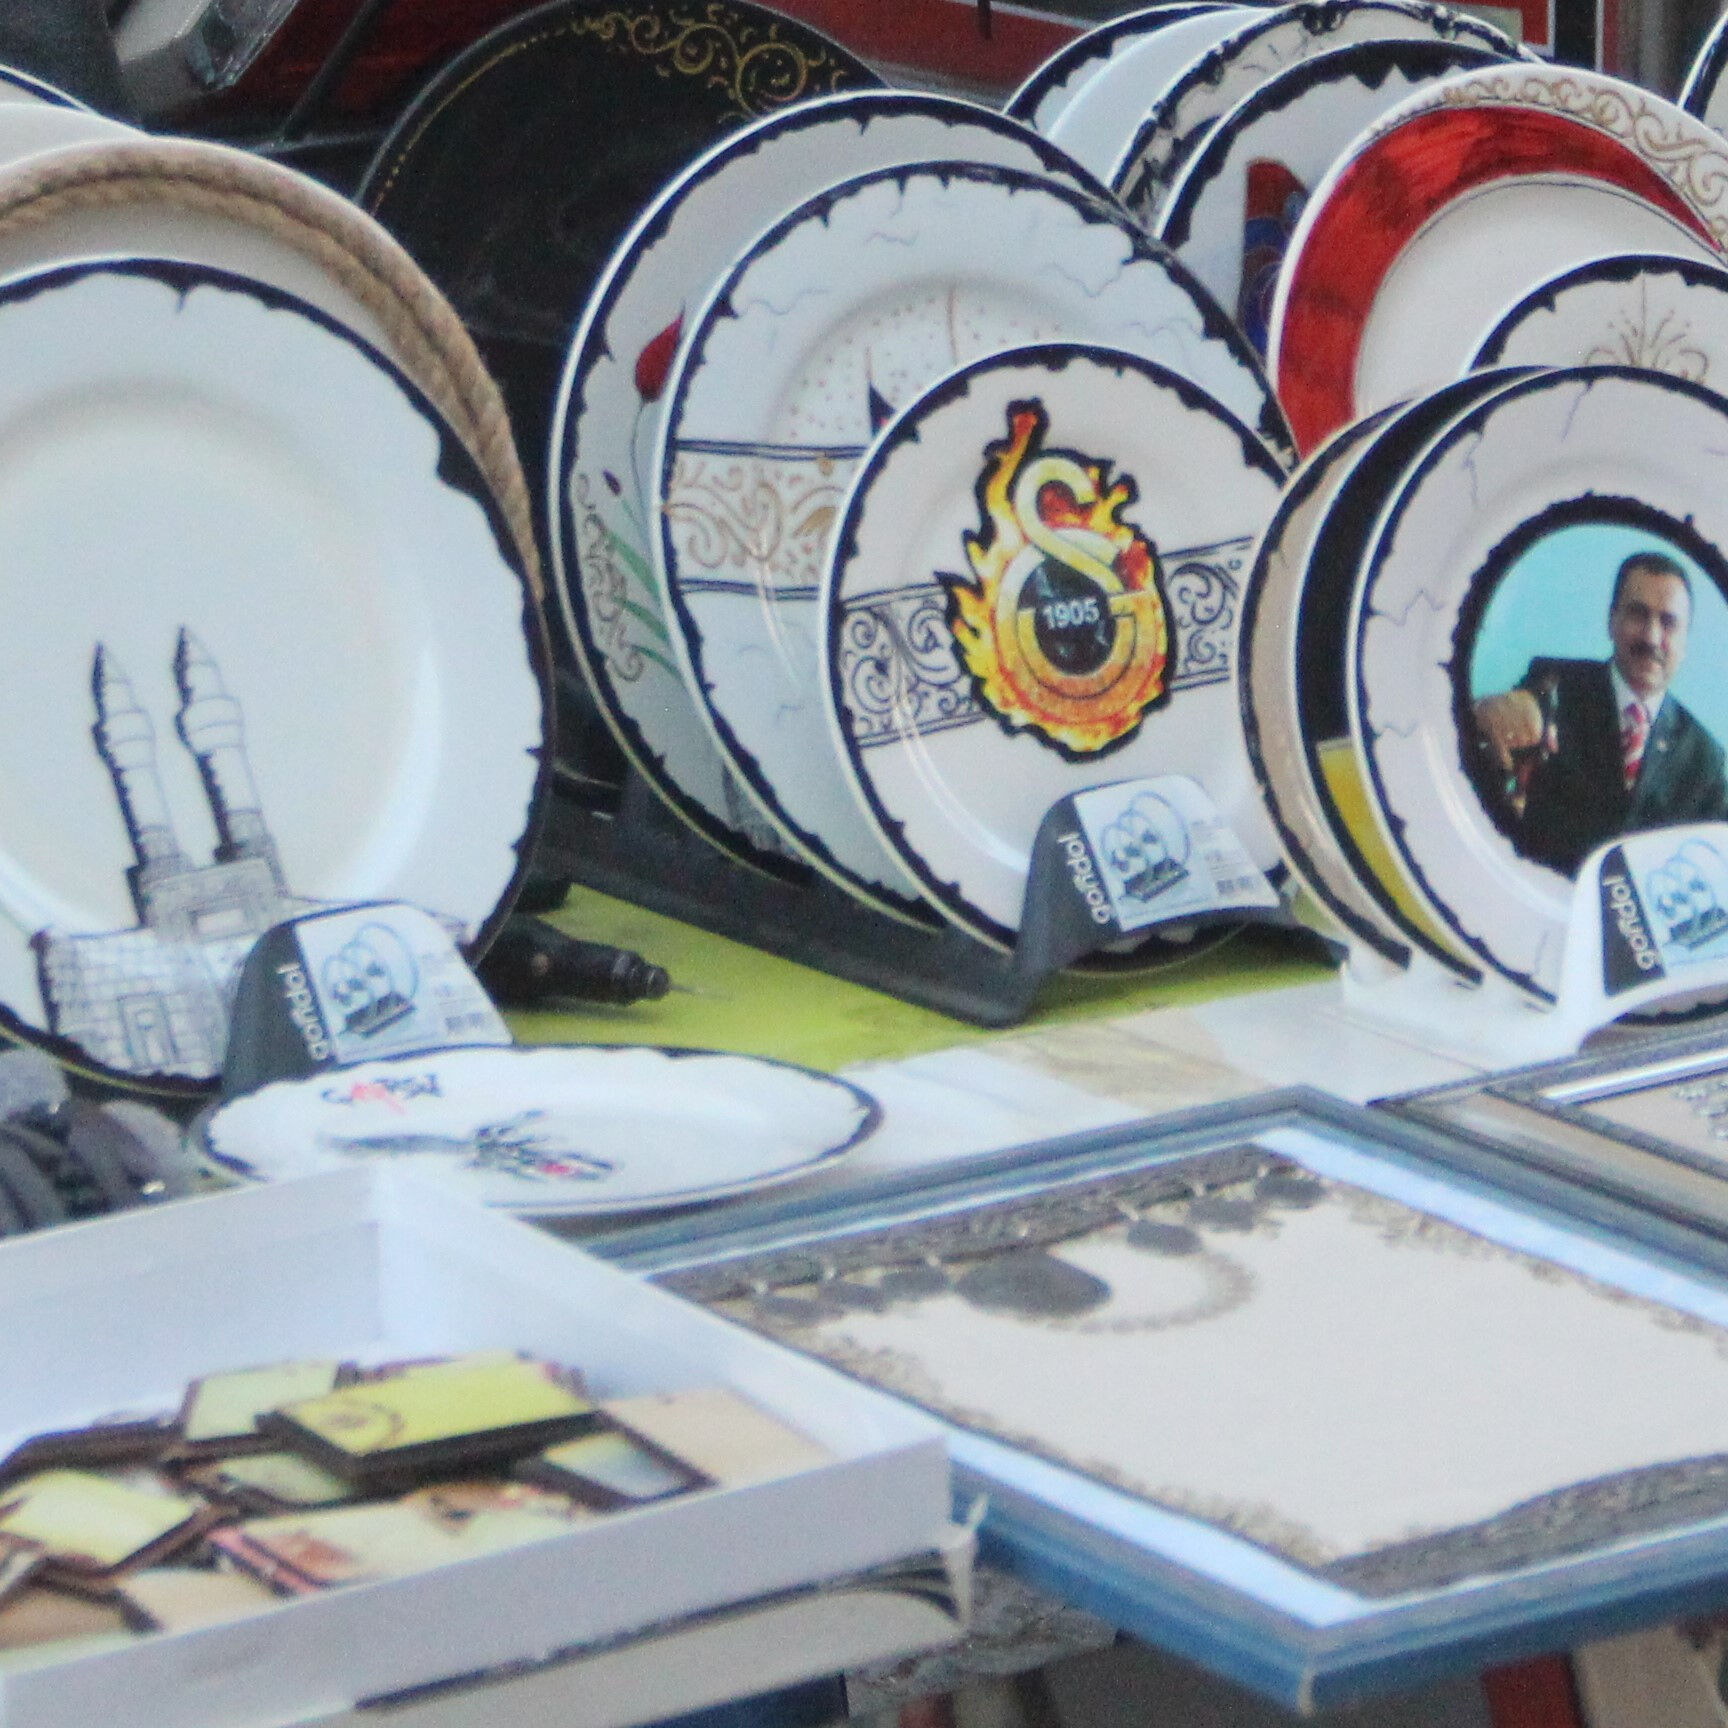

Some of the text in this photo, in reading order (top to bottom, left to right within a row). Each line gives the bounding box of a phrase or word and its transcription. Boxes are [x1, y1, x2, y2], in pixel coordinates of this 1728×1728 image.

[1042, 598, 1101, 630] 1905
[1057, 831, 1112, 925] gondol
[1603, 876, 1657, 971] gondol
[276, 963, 329, 1061] gondol
